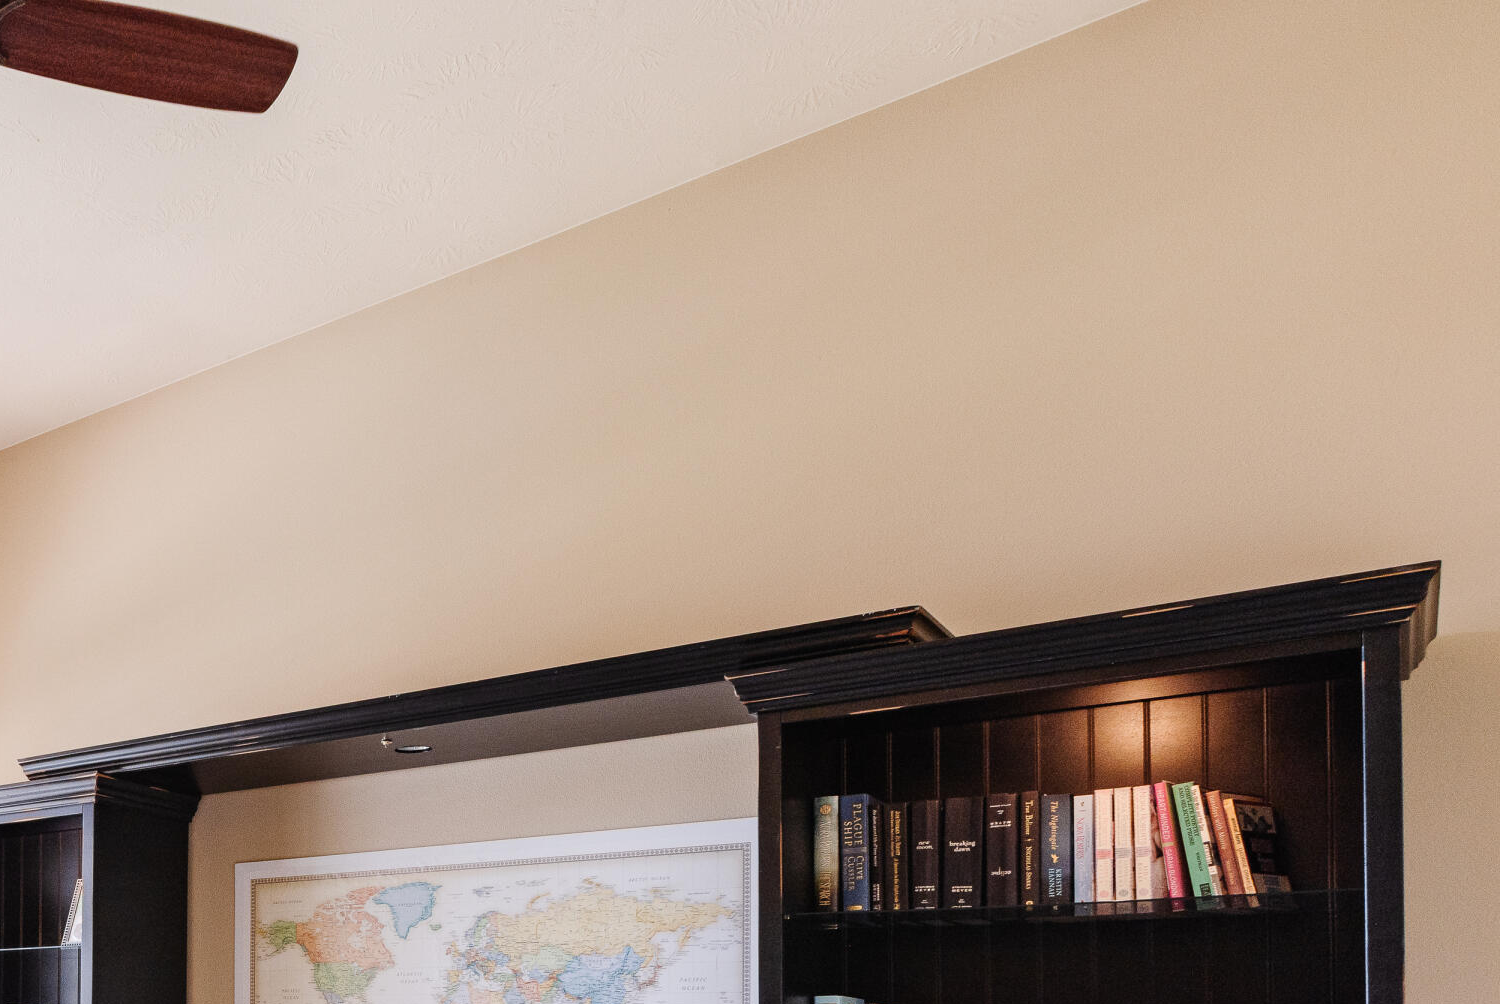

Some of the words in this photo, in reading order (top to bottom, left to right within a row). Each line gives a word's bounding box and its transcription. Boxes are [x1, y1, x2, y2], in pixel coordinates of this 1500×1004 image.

[853, 803, 863, 845] PLAGUE
[1157, 789, 1165, 812] HEART
[1161, 814, 1170, 840] MINDED
[844, 821, 852, 846] SHIP
[1049, 815, 1058, 850] Nightingale
[856, 855, 864, 880] CLIVE
[990, 866, 1012, 877] eclipse
